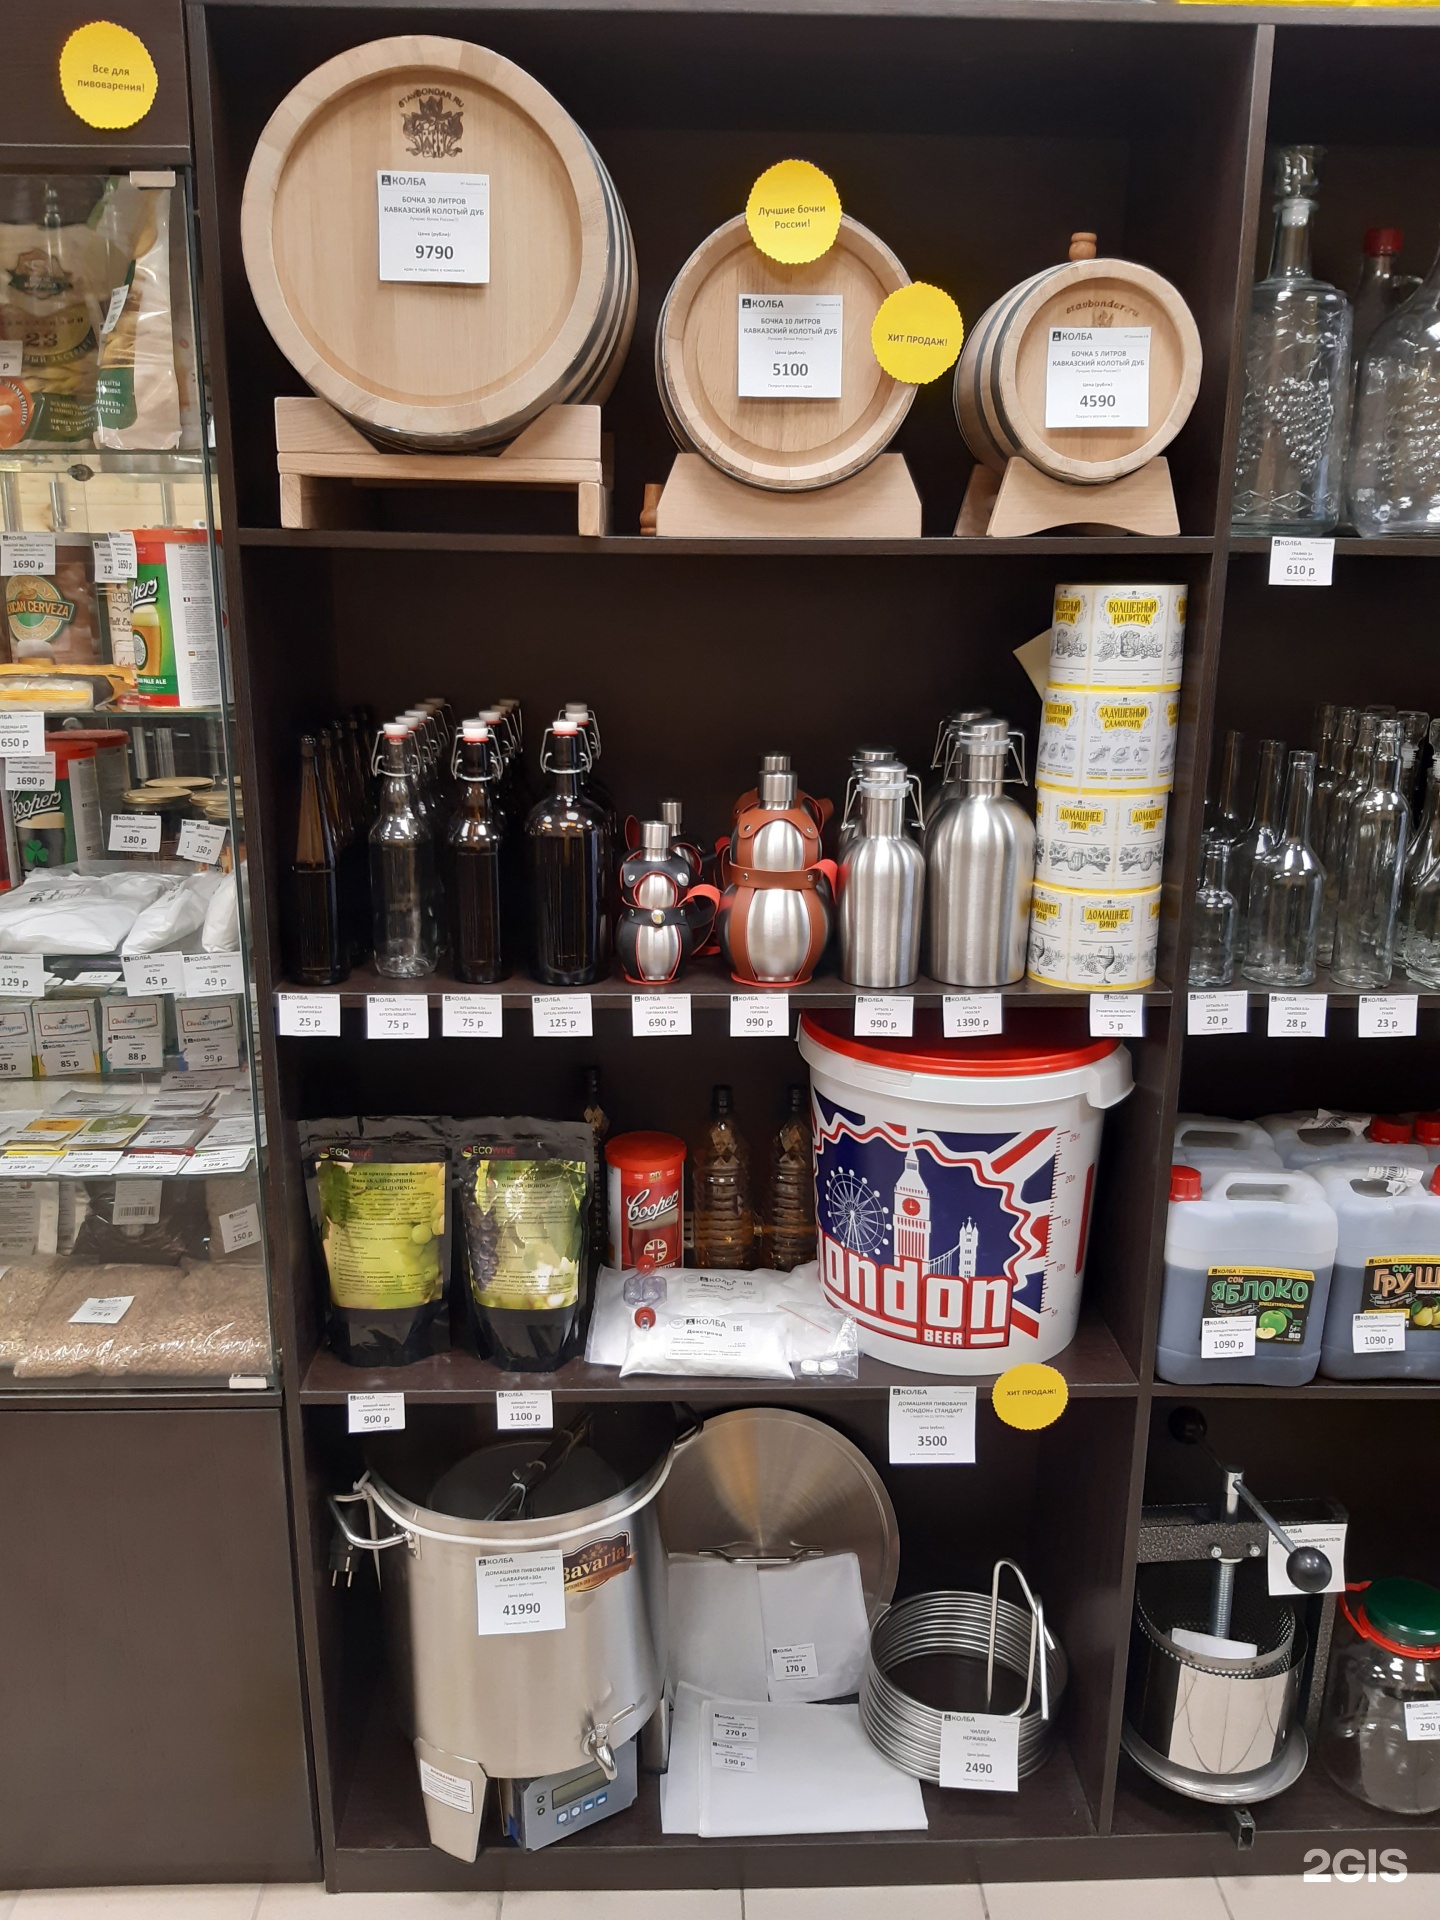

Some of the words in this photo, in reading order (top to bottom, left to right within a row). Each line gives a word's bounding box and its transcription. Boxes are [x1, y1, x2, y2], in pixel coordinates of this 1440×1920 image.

[92, 64, 109, 75] Все
[111, 66, 130, 77] для
[77, 79, 145, 93] пивоварения!
[392, 176, 426, 186] КОЛБА
[402, 196, 426, 204] БОЧКА
[427, 197, 437, 205] 30
[438, 197, 467, 205] ЛИТРОВ
[384, 205, 431, 215] КАВКАЗСКИЙ
[432, 206, 469, 216] КОЛОТЫЙ
[469, 208, 485, 217] ДУБ
[758, 205, 796, 217] Лучшие
[797, 204, 826, 214] бочки
[774, 219, 811, 230] России!
[415, 245, 454, 260] 9790
[1066, 299, 1140, 318] stavbondar.ru
[743, 327, 788, 335] КАВКАЗСКИЙ
[789, 327, 823, 335] КОЛОТЫЙ
[824, 327, 838, 336] ДУБ
[25, 332, 58, 348] 23
[887, 333, 905, 343] ХИТ
[906, 335, 948, 347] ПРОДАЖ!
[1052, 359, 1095, 367] КАВКАЗСКИЙ
[1096, 359, 1130, 367] КОЛОТЫЙ
[1130, 359, 1145, 367] ДУБ
[772, 363, 809, 377] 5100
[1080, 394, 1116, 408] 4590
[12, 560, 36, 569] 1690
[37, 561, 44, 570] р
[117, 560, 129, 569] 1650
[129, 562, 133, 571] р
[1286, 565, 1306, 575] 610
[1308, 567, 1315, 577] р
[110, 592, 129, 602] LIGH
[1108, 600, 1157, 614] ВОЛШЕБНЫЙ
[1114, 613, 1151, 624] НАПИТОК
[1100, 707, 1147, 719] ЗАДУШЕБНЫЙ
[1104, 720, 1141, 729] САМОГОНЪ
[1, 738, 20, 747] 650
[22, 739, 29, 749] р
[16, 777, 38, 785] 1690
[39, 778, 45, 787] р
[1060, 808, 1101, 822] ДОМАШНЕЕ
[1070, 821, 1087, 830] ПИВО
[1143, 821, 1156, 830] ПИВО
[123, 835, 139, 844] 180
[140, 838, 147, 846] р
[196, 845, 208, 854] 150
[1087, 909, 1129, 920] ДОМАШНЕЕ
[1, 977, 20, 987] 129
[22, 979, 29, 988] р
[145, 976, 159, 985] 45
[161, 977, 168, 986] р
[204, 977, 217, 986] 49
[220, 978, 227, 987] р
[299, 1018, 312, 1026] 25
[314, 1019, 321, 1028] р
[387, 1020, 400, 1029] 75
[402, 1021, 409, 1031] р
[462, 1018, 475, 1027] 75
[477, 1019, 484, 1029] р
[549, 1018, 567, 1028] 125
[570, 1019, 577, 1029] р
[648, 1018, 667, 1027] 690
[669, 1019, 676, 1028] р
[745, 1018, 764, 1027] 990
[766, 1019, 773, 1028] р
[869, 1019, 888, 1028] 990
[891, 1021, 897, 1030] р
[956, 1018, 980, 1027] 1390
[983, 1018, 989, 1028] р
[1108, 1020, 1115, 1030] 5
[1117, 1022, 1124, 1031] р
[1206, 1015, 1219, 1025] 20
[1221, 1016, 1228, 1026] р
[1286, 1019, 1298, 1028] 28
[1300, 1020, 1307, 1029] р
[1377, 1019, 1389, 1028] 23
[1392, 1020, 1398, 1029] р
[128, 1052, 139, 1061] 88
[141, 1053, 147, 1061] р
[204, 1054, 215, 1062] 99
[217, 1055, 223, 1063] р
[60, 1060, 71, 1068] 85
[74, 1060, 79, 1068] р
[1069, 1132, 1081, 1143] 25л
[472, 1145, 516, 1155] ECOWINE
[1064, 1174, 1076, 1184] 20л
[626, 1188, 679, 1221] Coopers
[1061, 1217, 1071, 1228] 15л
[233, 1233, 247, 1243] 150
[1056, 1263, 1066, 1273] 10л
[1392, 1264, 1412, 1273] СОК
[709, 1277, 737, 1286] КОЛБА
[817, 1230, 1013, 1332] ondon
[1373, 1266, 1440, 1297] ГРУШ
[1211, 1278, 1309, 1305] ЯБЛОКО
[696, 1318, 727, 1329] КОЛБА
[686, 1329, 723, 1337] Декстроза
[923, 1329, 964, 1346] BEER
[1213, 1340, 1236, 1349] 1090
[1238, 1341, 1244, 1350] р
[1364, 1336, 1386, 1345] 1090
[1388, 1337, 1394, 1345] р
[1022, 1388, 1057, 1396] ПРОДАЖ!
[363, 1414, 382, 1424] 900
[383, 1416, 391, 1426] р
[509, 1412, 533, 1422] 1100
[534, 1413, 541, 1423] р
[917, 1435, 948, 1447] 3500
[563, 1544, 626, 1583] Bavaria
[485, 1568, 520, 1577] ДОМАШНЯЯ
[521, 1566, 556, 1574] ПИВОВАРНЯ
[502, 1602, 541, 1616] 41990
[785, 1665, 799, 1673] 170
[801, 1665, 806, 1673] р
[1420, 1722, 1436, 1731] 290
[965, 1762, 993, 1774] 2490
